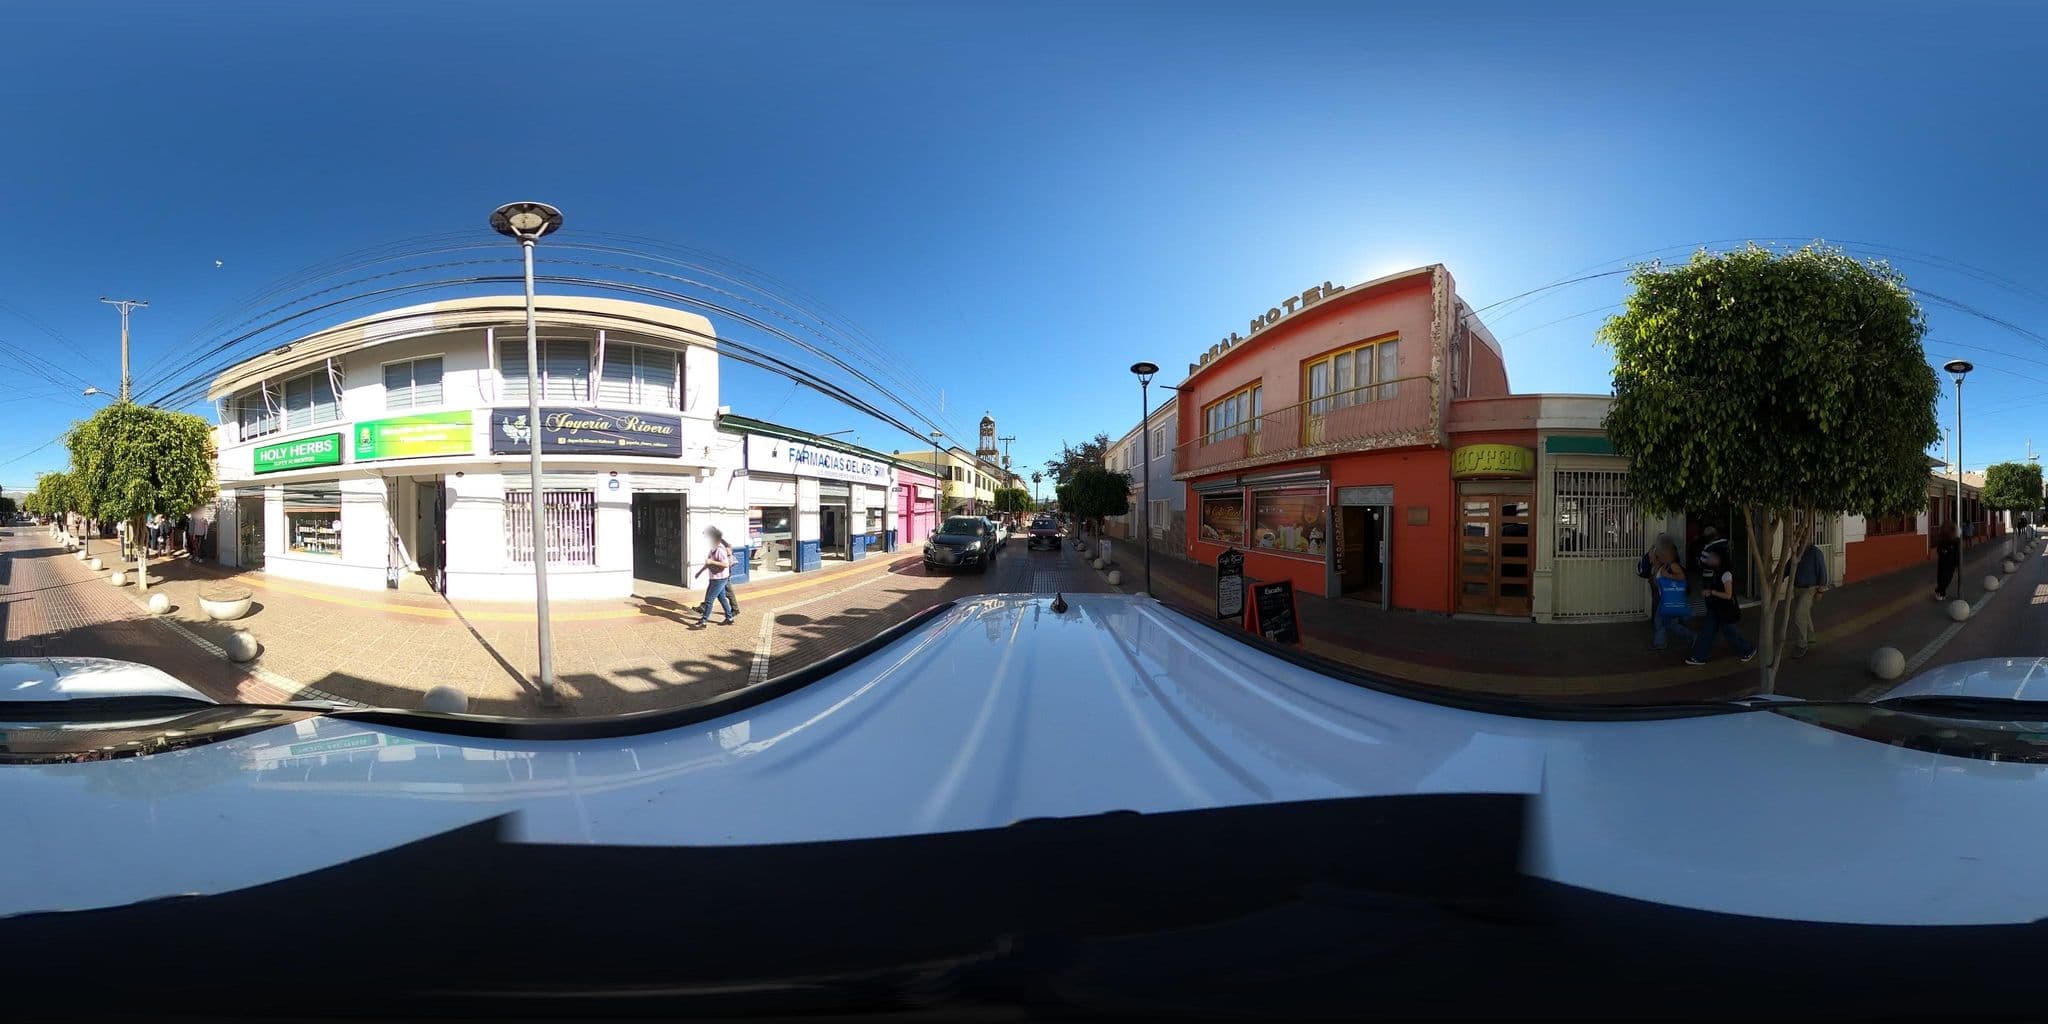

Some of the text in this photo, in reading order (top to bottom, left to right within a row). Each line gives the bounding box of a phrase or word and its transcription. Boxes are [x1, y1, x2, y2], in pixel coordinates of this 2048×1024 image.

[1250, 281, 1345, 334] HOTEL
[616, 415, 673, 434] Rivera
[260, 440, 333, 462] HOLY HERBS
[788, 447, 844, 470] FARMACIAS
[846, 459, 860, 472] DEL
[1455, 449, 1522, 473] HOTEL
